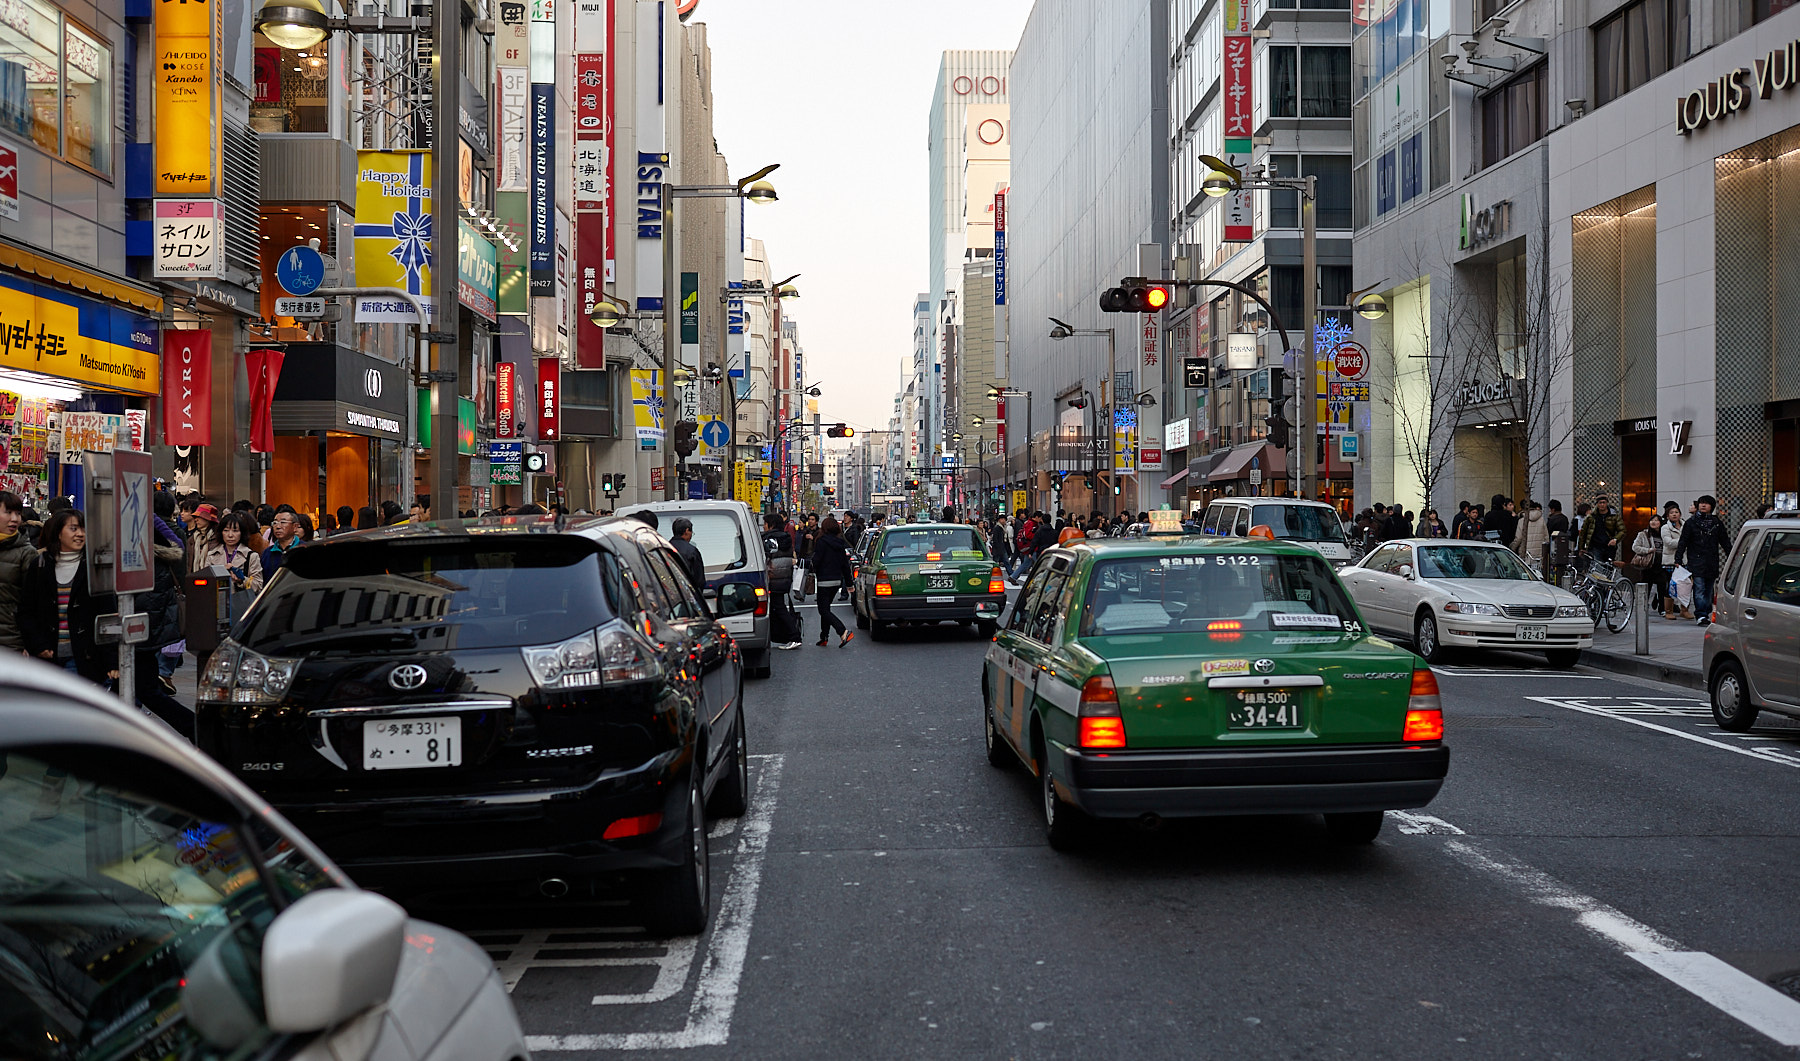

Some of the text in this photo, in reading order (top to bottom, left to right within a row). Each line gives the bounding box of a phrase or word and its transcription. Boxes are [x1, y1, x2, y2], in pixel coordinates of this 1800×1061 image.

[506, 49, 519, 59] 6F
[166, 75, 203, 83] Kanebo
[505, 75, 524, 89] 3F
[1676, 67, 1747, 135] LOUIS
[505, 94, 524, 143] HAIR
[362, 169, 408, 184] Happy
[537, 95, 547, 244] NEAL'S YARD REMEDIES
[580, 151, 597, 193] 北海道
[1380, 165, 1393, 200] GAP
[638, 151, 670, 239] ISETAN
[177, 203, 195, 215] 3F
[161, 225, 210, 239] ネイル
[161, 244, 210, 258] サロン
[160, 264, 212, 272] Sweetie Nail
[996, 252, 1004, 299] プロキャリア
[196, 282, 236, 307] JAYRO
[584, 267, 595, 315] 無印良品
[280, 302, 320, 312] 歩行者優先
[1144, 314, 1157, 366] 大和証券
[79, 354, 146, 380] Matsumoto KiYoshi
[1337, 357, 1361, 367] 消火栓
[182, 347, 192, 430] JAYRO
[1342, 388, 1369, 396] セキネ
[544, 381, 553, 418] 無印良品
[66, 414, 104, 428] 人気ブランド
[347, 411, 377, 429] SAMANTHA
[1634, 422, 1649, 431] LOUIS
[66, 451, 82, 462] マツ
[1158, 521, 1176, 530] 5122
[1160, 556, 1260, 566] 東京無線 5122
[1343, 621, 1361, 632] 54
[1522, 632, 1545, 640] 82-43
[1245, 693, 1287, 704] 練馬 500
[1231, 705, 1298, 726] い 34-41
[388, 722, 437, 736] 多摩 331
[370, 749, 382, 759] ぬ
[526, 744, 594, 758] HARRIER
